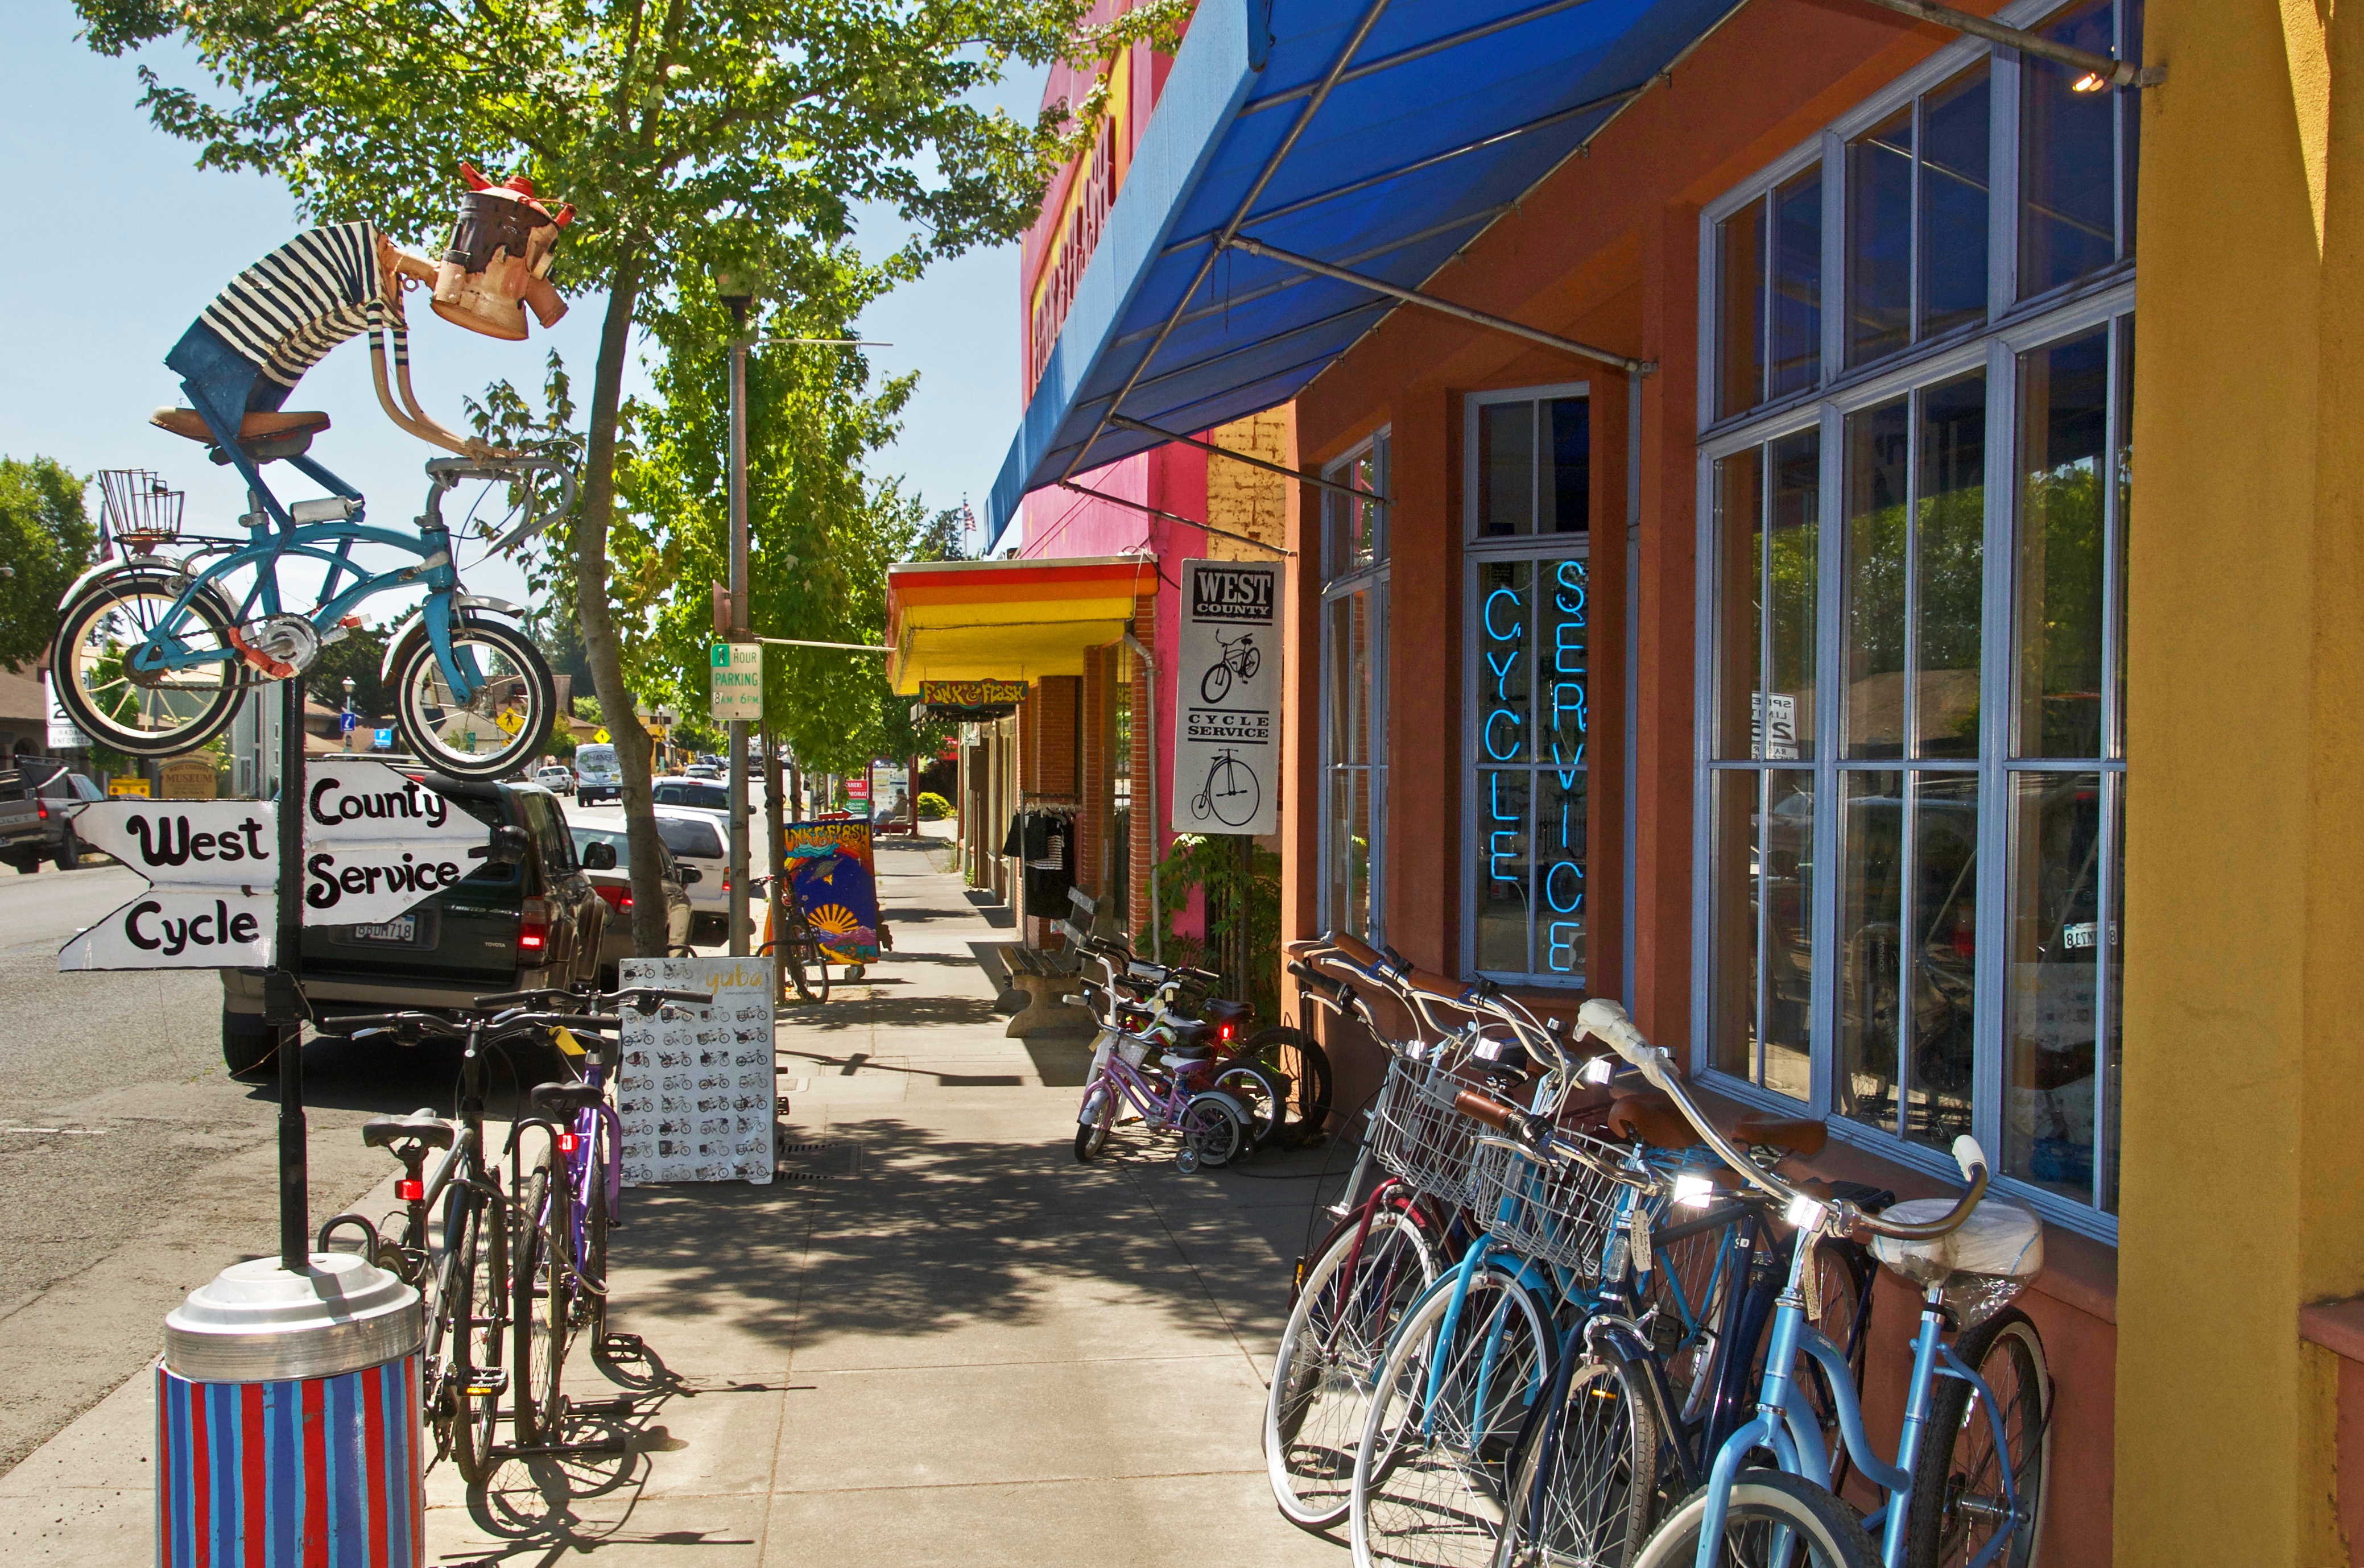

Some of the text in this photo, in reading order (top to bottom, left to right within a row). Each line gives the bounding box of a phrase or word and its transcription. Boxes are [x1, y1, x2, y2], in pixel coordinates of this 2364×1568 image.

[1197, 572, 1271, 605] WEST
[1197, 603, 1270, 615] COUNTY
[733, 652, 757, 663] HOUR
[714, 672, 758, 686] PARKING
[966, 685, 981, 702] &
[1188, 714, 1269, 727] CYCLE
[1188, 726, 1268, 738] SERVICE
[1485, 589, 1520, 880] CYCLE
[166, 774, 213, 783] MUSEUM
[1547, 561, 1586, 971] SERVICE
[310, 778, 446, 828] County
[126, 815, 270, 866] West
[785, 829, 816, 851] UNK
[307, 853, 460, 909] Service
[125, 900, 260, 955] Cycle
[706, 963, 763, 995] yuba
